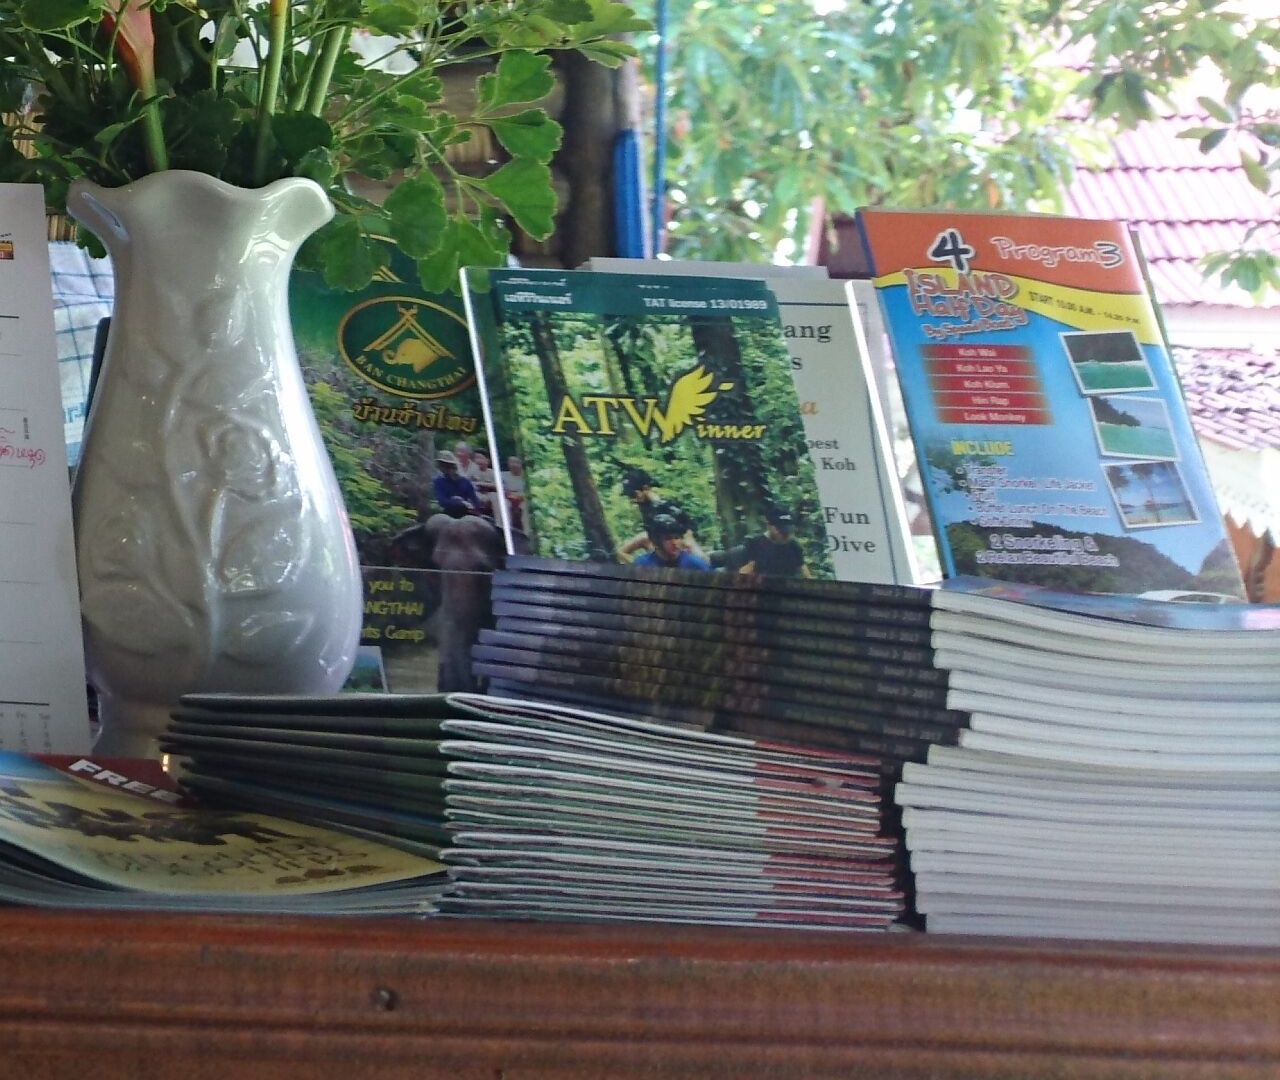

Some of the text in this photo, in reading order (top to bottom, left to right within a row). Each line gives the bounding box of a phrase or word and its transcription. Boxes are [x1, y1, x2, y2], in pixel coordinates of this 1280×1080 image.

[928, 229, 975, 272] 4
[903, 268, 1019, 299] ISLAND
[642, 297, 666, 308] TAT
[353, 397, 477, 433] บ้านช้างไทย
[951, 441, 1014, 456] INCLUDE
[821, 456, 856, 472] Koh
[824, 506, 871, 525] Fun
[991, 534, 1002, 549] 2
[368, 577, 414, 594] you to
[385, 625, 426, 643] Camp
[68, 758, 184, 804] FREE
